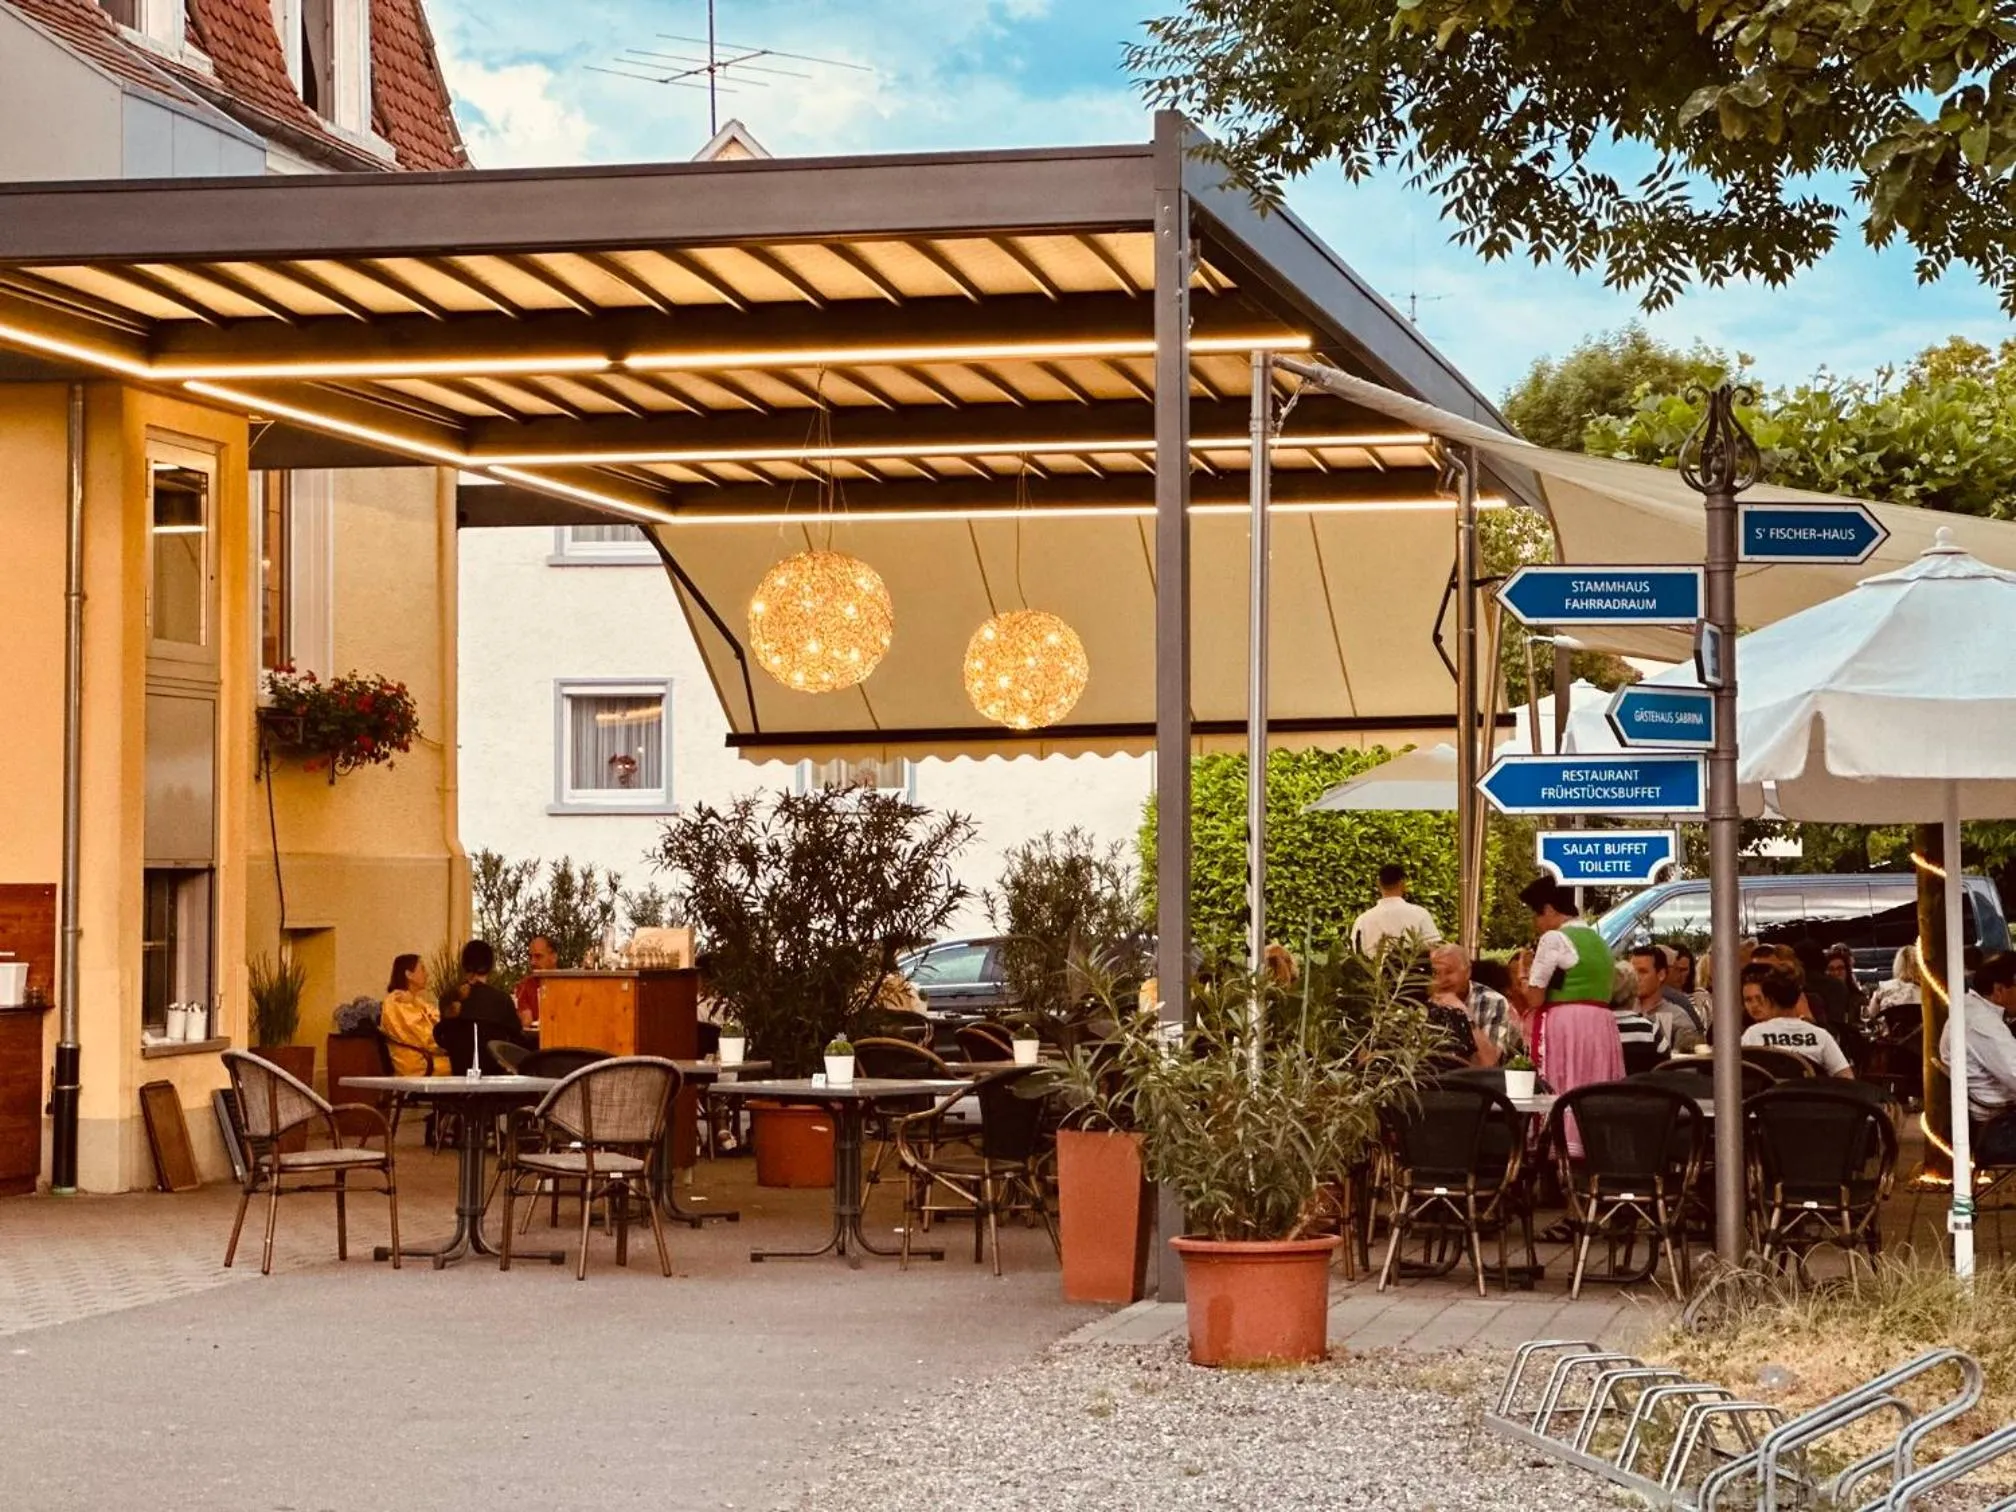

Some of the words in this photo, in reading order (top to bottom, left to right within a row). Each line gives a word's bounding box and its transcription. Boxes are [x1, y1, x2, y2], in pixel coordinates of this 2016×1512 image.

[1769, 528, 1856, 540] FISCHER-HAUS
[1571, 581, 1650, 593] STAMMHAUS
[1565, 598, 1657, 610] FAHRRADRAUM
[1633, 707, 1674, 724] GÄSTEHAUS
[1675, 711, 1704, 725] SABRINA
[1562, 769, 1640, 781] RESTAURANT
[1541, 784, 1662, 799] FRÜHSTÜCKSBUFFET
[1563, 843, 1600, 855] SALAT
[1604, 843, 1648, 855] BUFFET
[1578, 860, 1632, 872] TOILETTE
[1762, 1032, 1818, 1046] nasa
